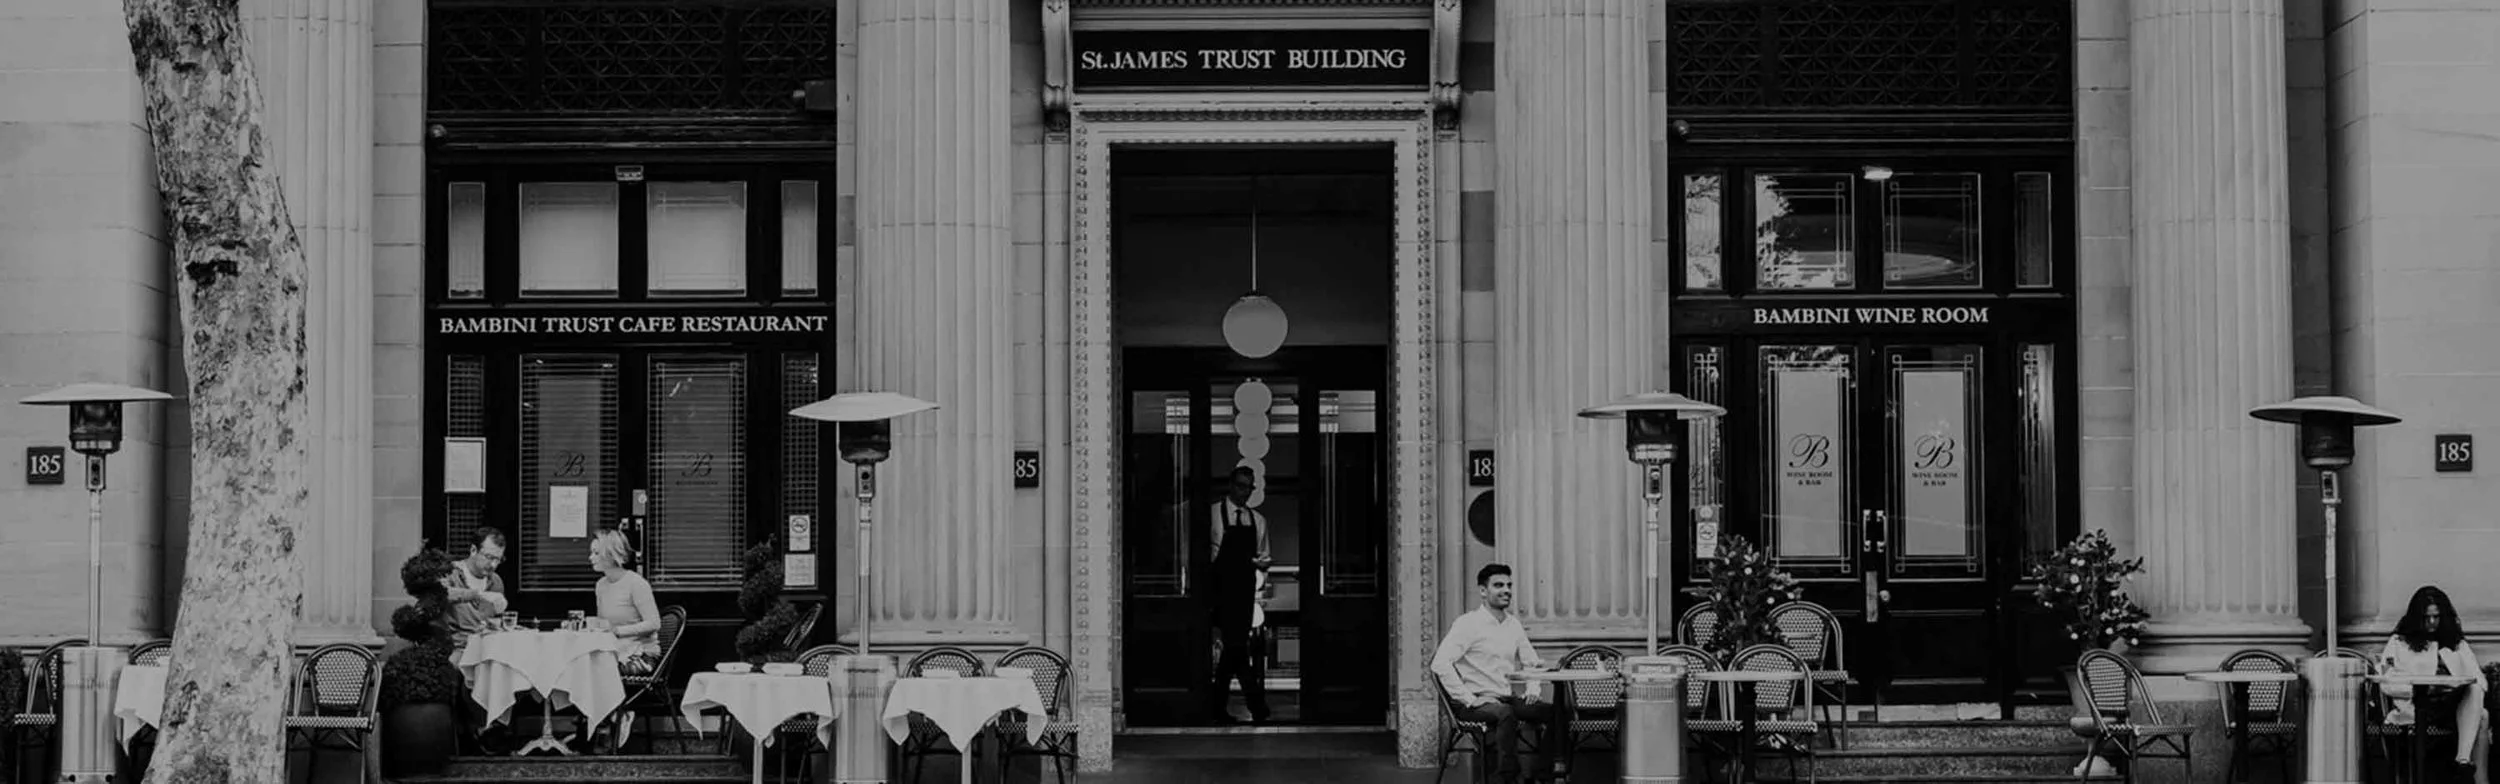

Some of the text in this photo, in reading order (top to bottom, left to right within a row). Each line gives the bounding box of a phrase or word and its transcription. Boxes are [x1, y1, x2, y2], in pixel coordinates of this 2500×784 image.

[1198, 49, 1276, 70] TRUST
[1287, 48, 1407, 69] BUILDING
[440, 315, 828, 333] BAMBINI TRUST CAFE RESTAURANT
[1753, 307, 1989, 324] BAMBINI WINE ROOM
[1789, 433, 1830, 469] B
[1914, 434, 1956, 469] B
[2440, 442, 2470, 462] 185
[30, 455, 61, 475] 185
[1015, 458, 1037, 478] 85
